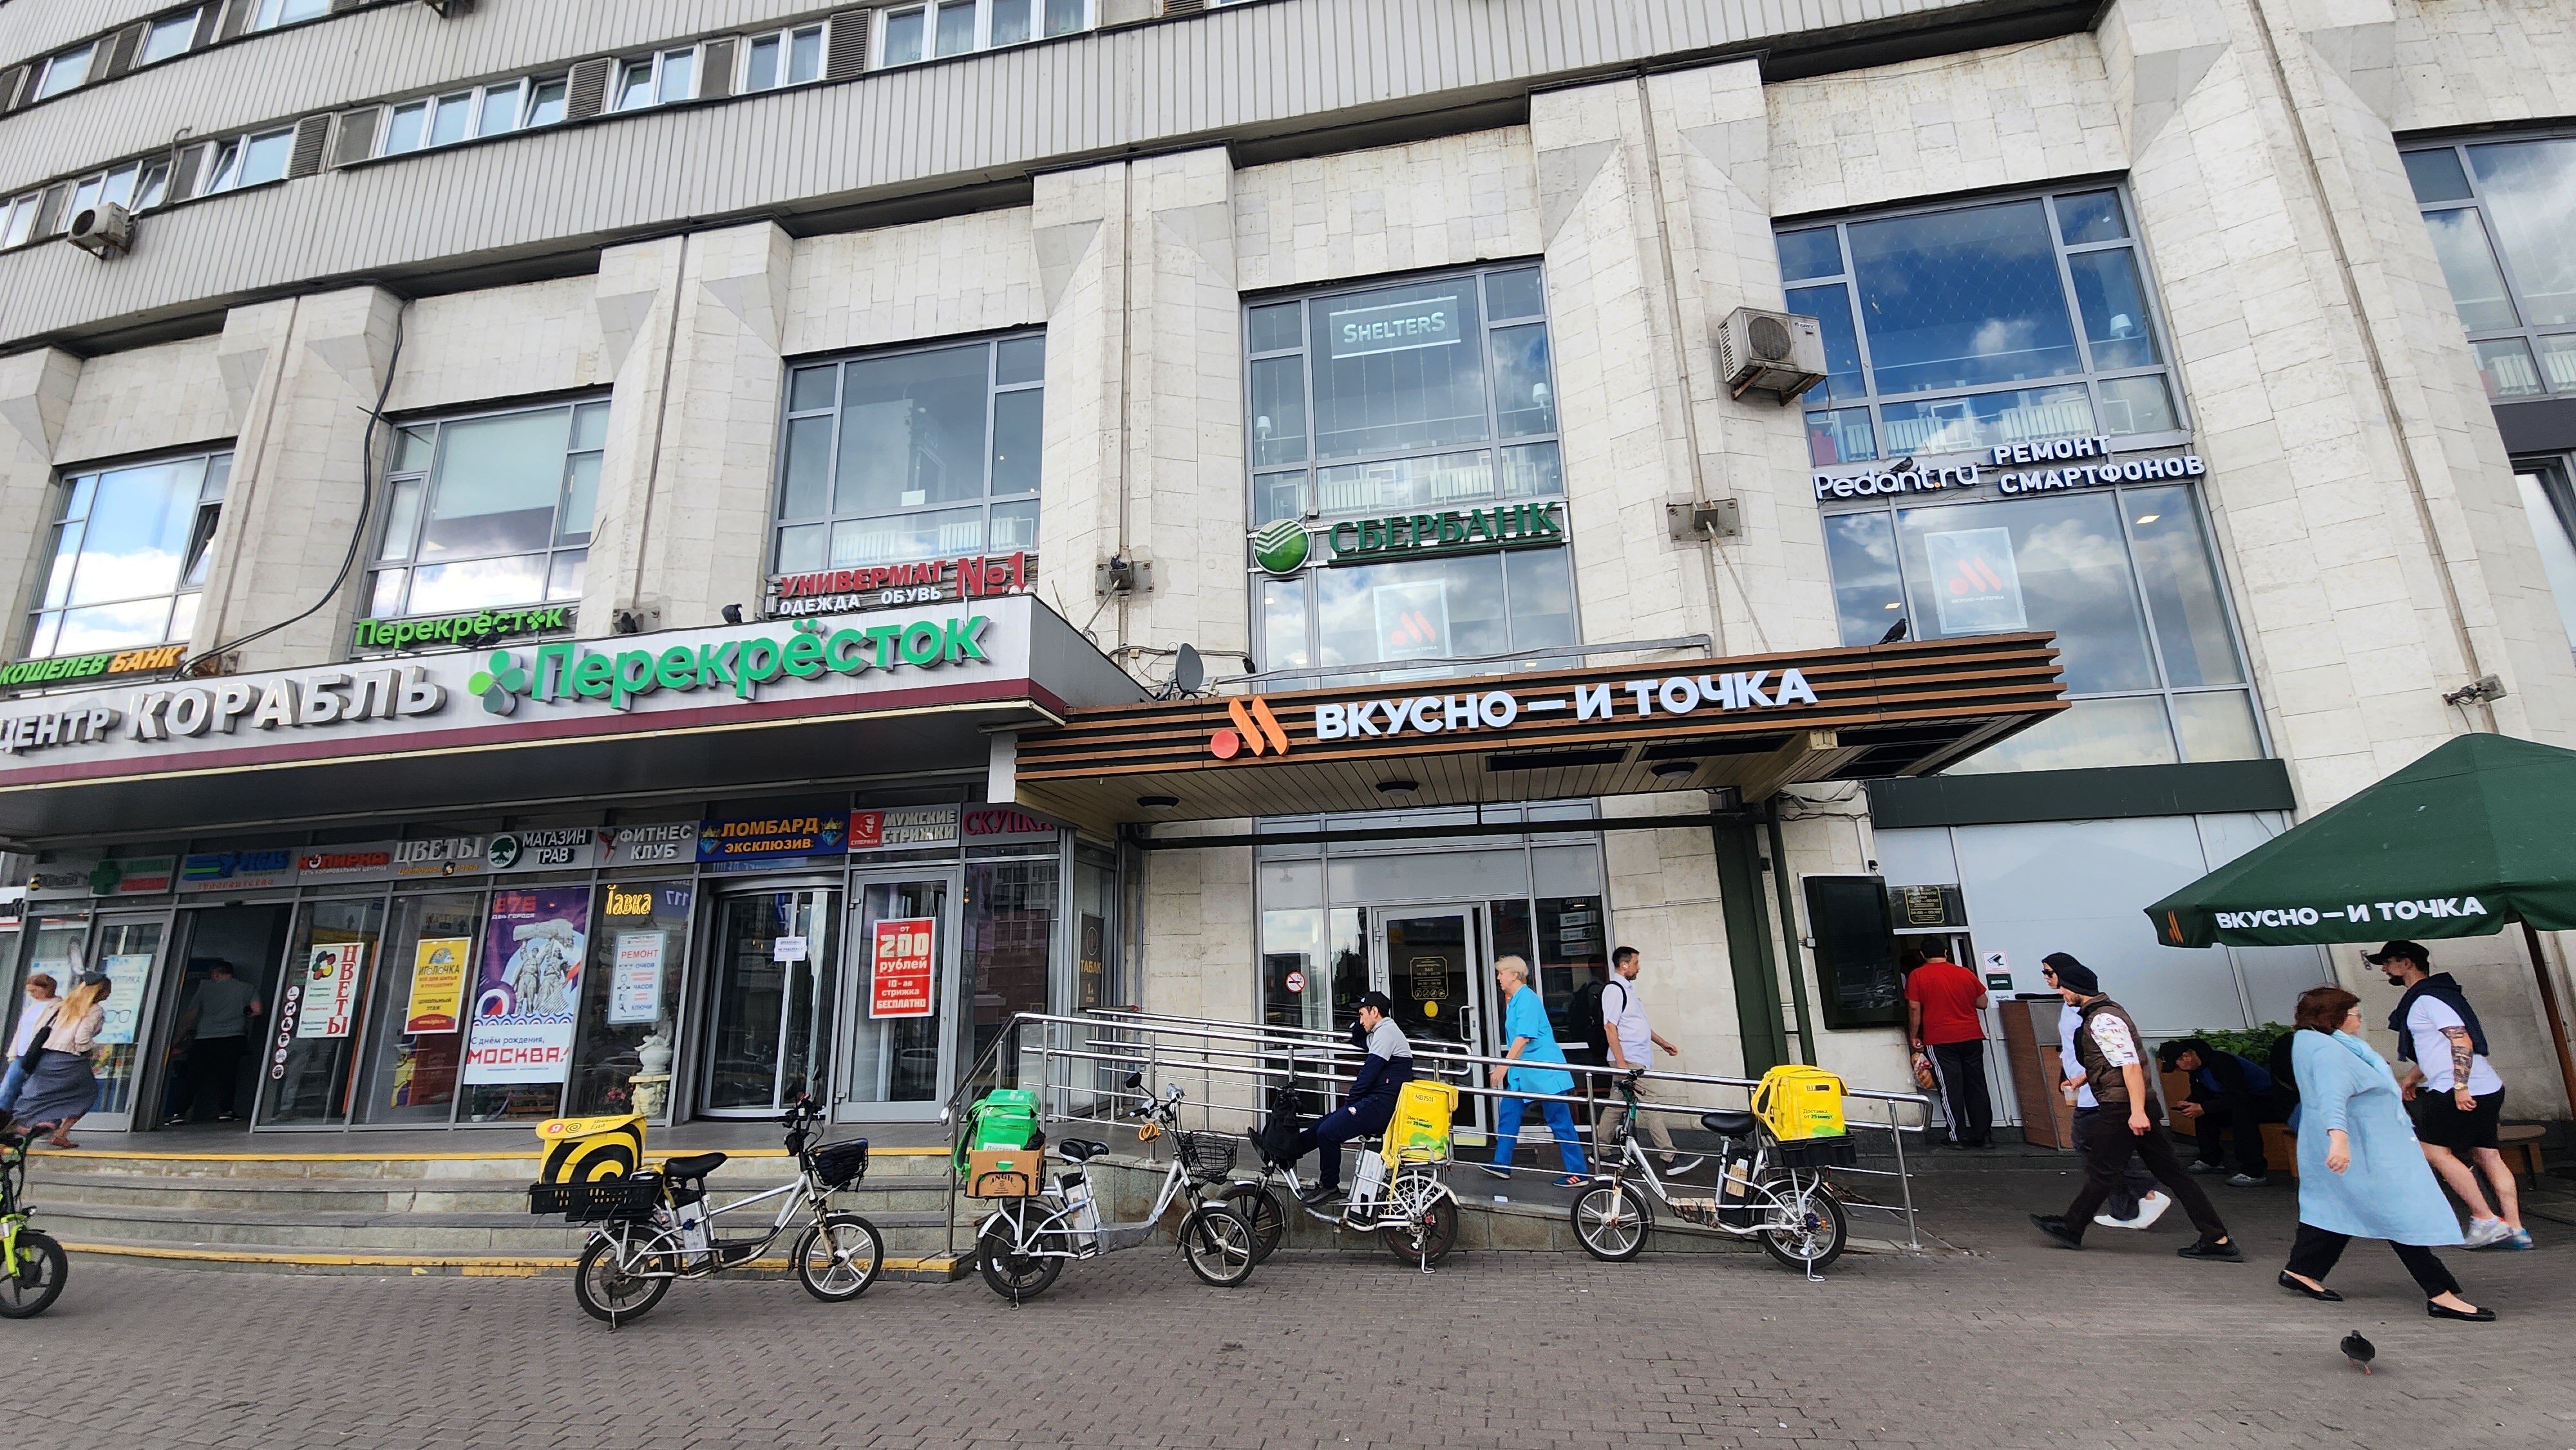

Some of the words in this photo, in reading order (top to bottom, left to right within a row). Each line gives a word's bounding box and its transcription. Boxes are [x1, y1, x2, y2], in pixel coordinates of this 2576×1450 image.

[1993, 435, 2110, 466] РЕМОНТ
[1812, 464, 1979, 501] Pedant.ru
[1998, 455, 2206, 495] СМАРТФОНОВ
[1329, 501, 1562, 554] СБЕРБАНК
[778, 560, 949, 598] УНИВЕРМАГ
[779, 594, 861, 616] ОДЕЖДА
[880, 586, 942, 604] ОБУВЬ
[0, 654, 110, 684] КОШЕЛЕВ
[108, 646, 186, 673] БАНК
[531, 616, 994, 711] Перекрёсток
[0, 708, 121, 754] ЦЕНТР
[126, 665, 446, 742] КОРАБЛЬ
[1314, 690, 1517, 741] ВКУСНО
[1575, 683, 1613, 721] И
[1625, 668, 1819, 717] ТОЧКА
[721, 817, 819, 837] ЛОМБАРД
[883, 810, 956, 827] МУЖСКИЕ
[522, 829, 587, 847] МАГАЗИН
[619, 825, 692, 842] ФИТНЕС
[882, 825, 955, 843] СТРИЖКИ
[393, 837, 483, 865] ЦВЕТЫ
[535, 848, 569, 864] ТРАВ
[630, 843, 677, 861] КЛУБ
[724, 838, 811, 854] ЭКСКЛЮЗИВ
[2215, 906, 2318, 928] ВКУСНО
[2348, 905, 2370, 922] И
[2375, 896, 2487, 921] ТОЧКА
[621, 950, 659, 959] РЕМОНТ
[879, 932, 929, 957] 200
[879, 957, 927, 973] рублей
[1081, 959, 1102, 975] ТАБАК
[327, 945, 359, 1035] ЦВЕТЫ
[882, 988, 920, 997] стрижка
[876, 999, 926, 1009] БЕСПЛАТНО
[478, 1037, 500, 1045] днём
[467, 1047, 570, 1064] МОСКВА!
